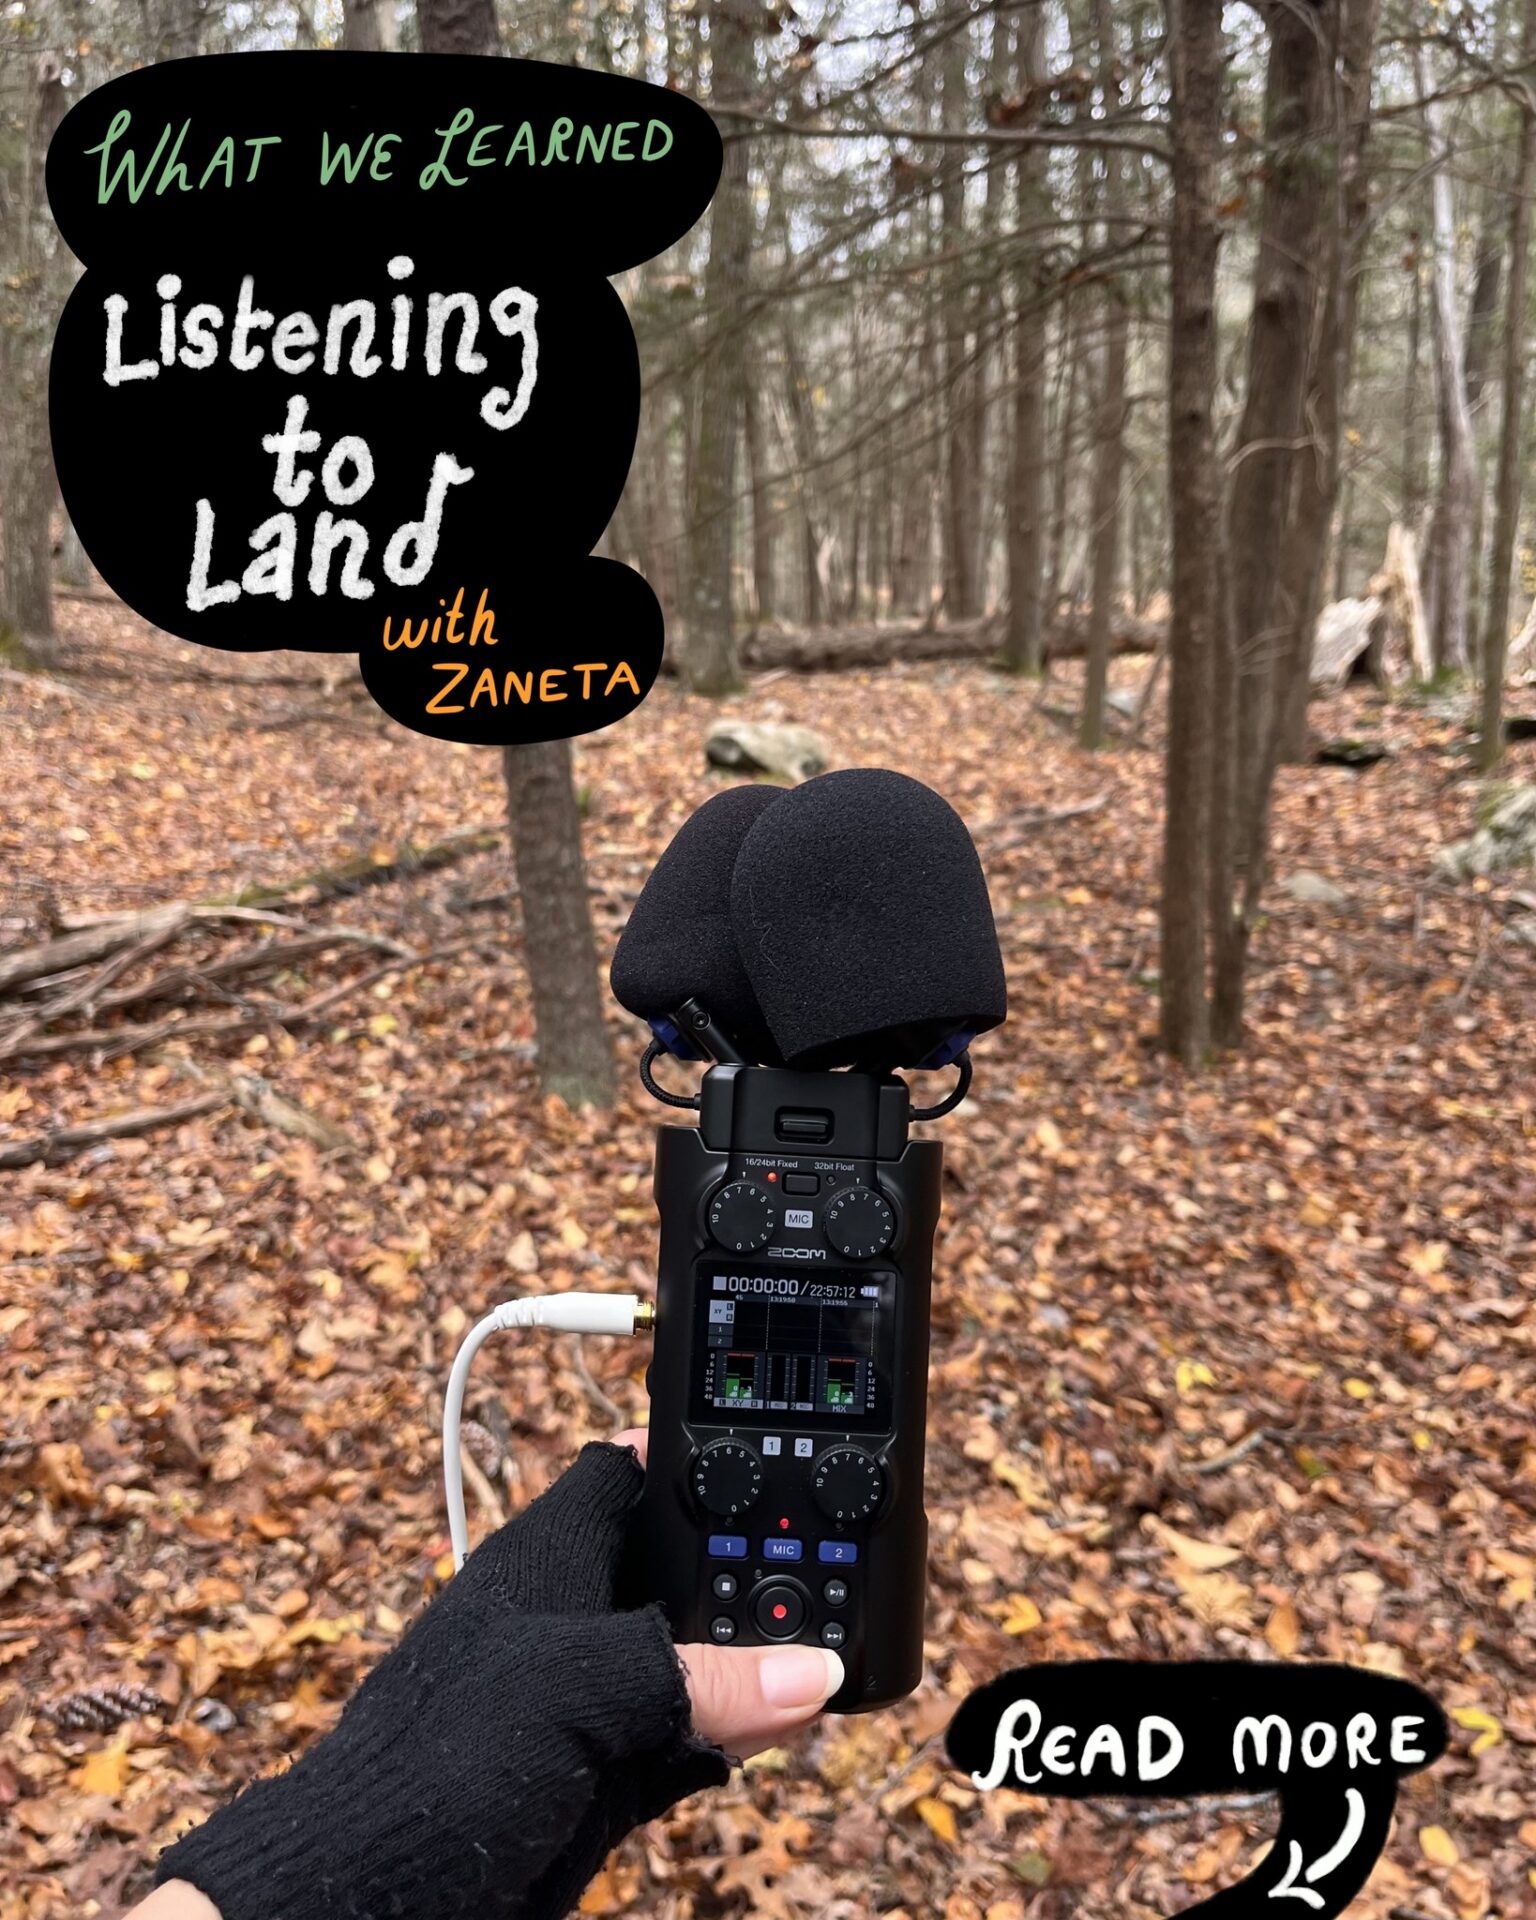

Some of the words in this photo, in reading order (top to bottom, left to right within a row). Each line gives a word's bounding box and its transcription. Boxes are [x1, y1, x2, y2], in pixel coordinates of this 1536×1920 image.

[746, 1158, 775, 1167] 16/24bit
[777, 1160, 798, 1168] Fixed
[814, 1162, 834, 1170] 32bit
[788, 1214, 809, 1223] MIC
[768, 1247, 826, 1260] ZOOM
[832, 1405, 847, 1413] MIX
[769, 1441, 774, 1450] 1
[800, 1443, 807, 1452] 2
[727, 1543, 730, 1551] 1
[773, 1545, 794, 1555] MIC
[836, 1548, 842, 1558] 2
